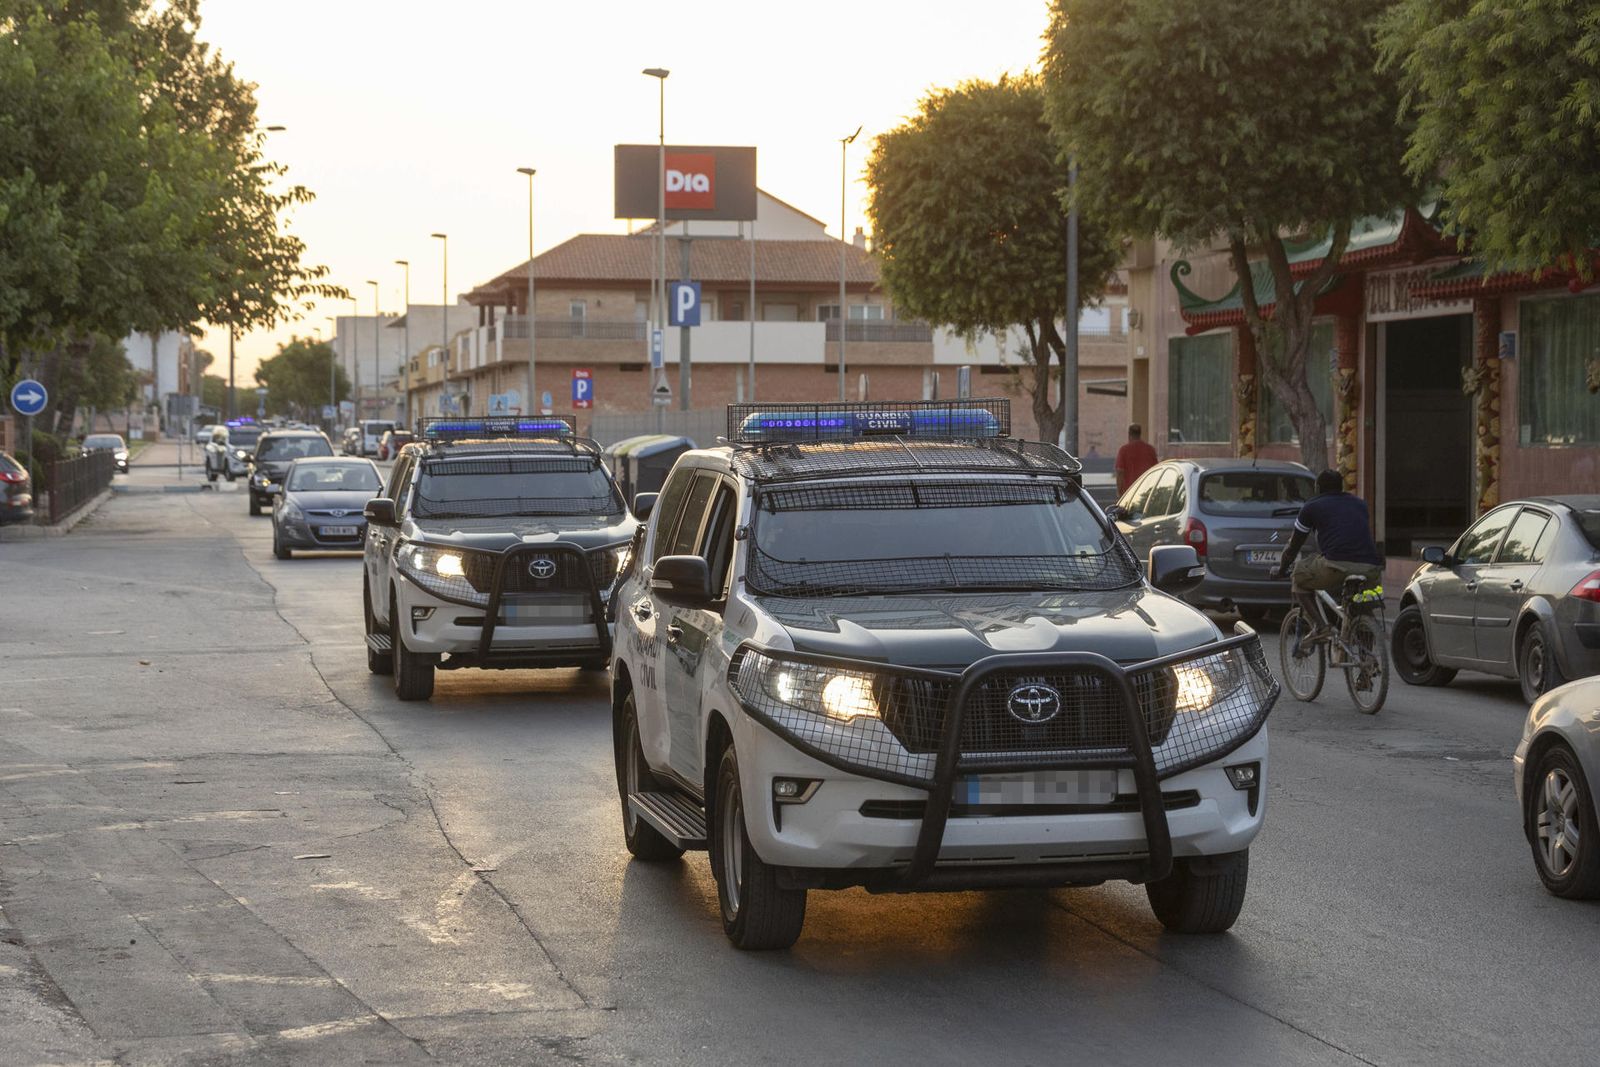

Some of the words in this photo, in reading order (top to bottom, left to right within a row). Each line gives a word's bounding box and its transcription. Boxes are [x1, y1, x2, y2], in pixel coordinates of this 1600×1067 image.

[677, 285, 695, 322] P
[577, 380, 587, 399] P
[868, 420, 901, 428] CIVIL
